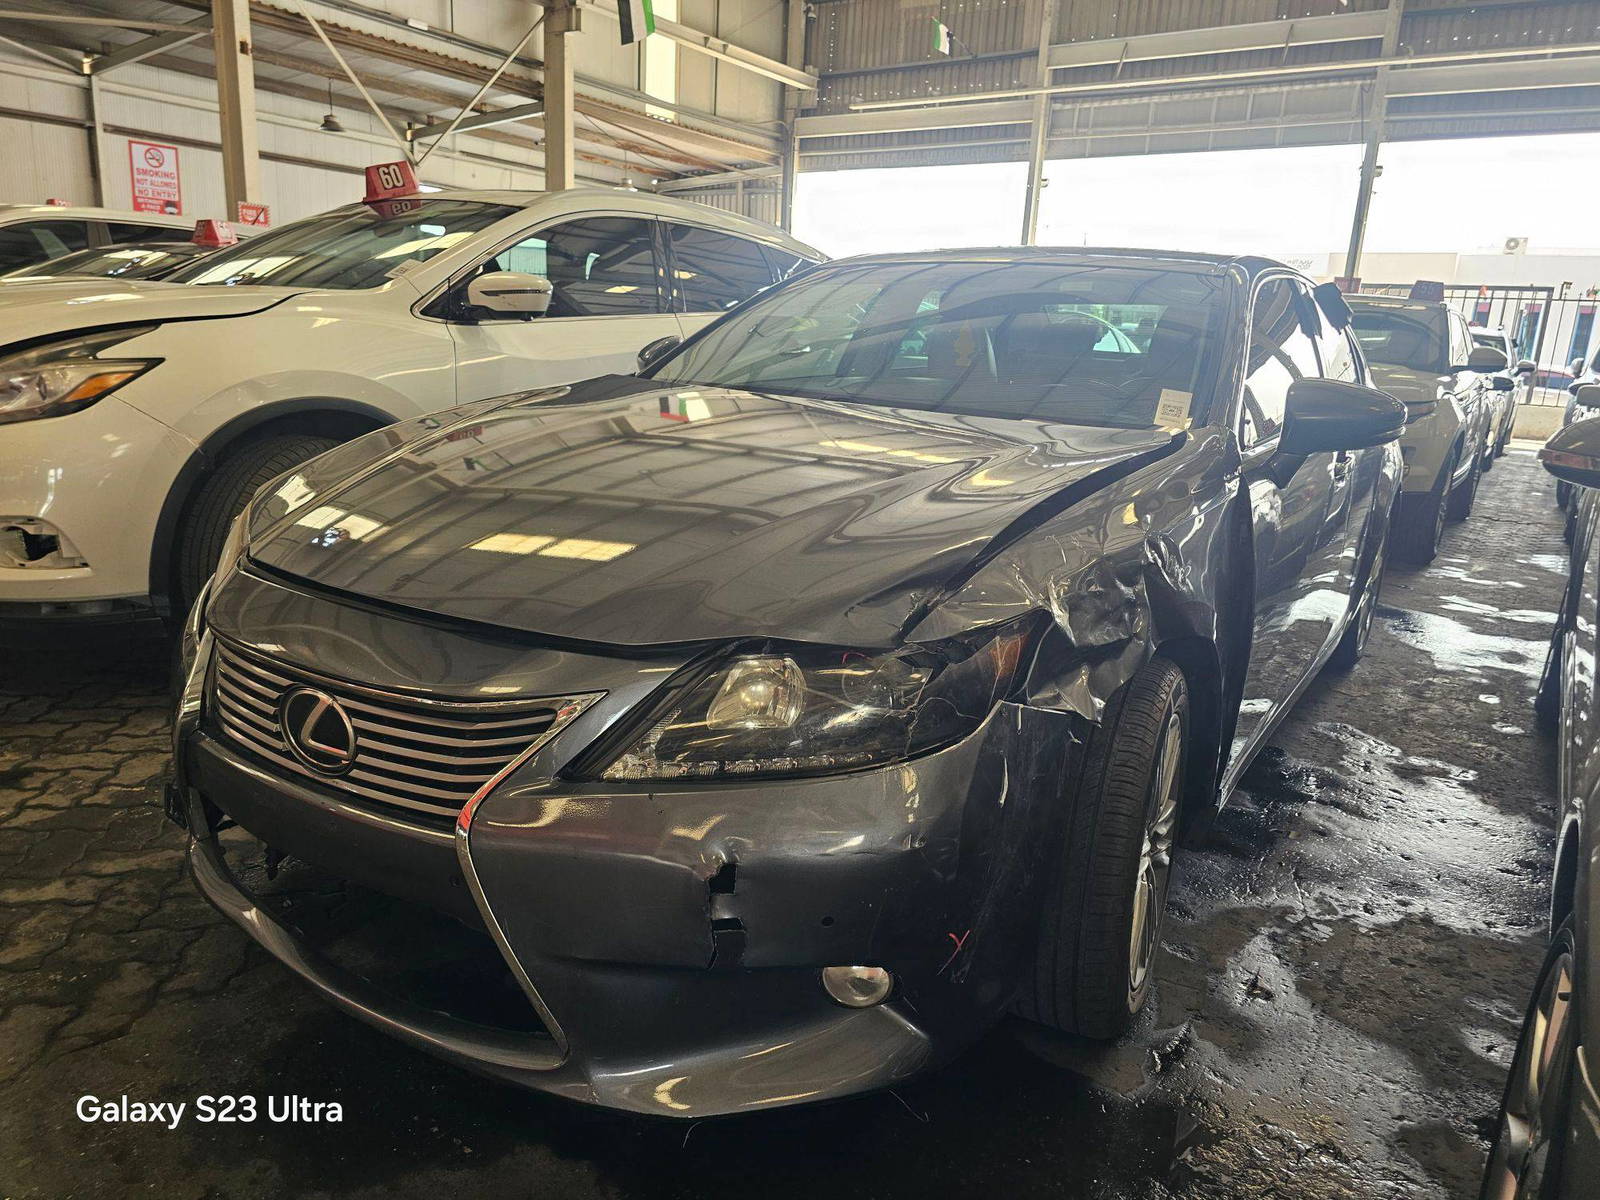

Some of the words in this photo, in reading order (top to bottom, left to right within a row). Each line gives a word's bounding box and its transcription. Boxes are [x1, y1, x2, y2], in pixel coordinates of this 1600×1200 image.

[136, 168, 175, 179] SMOKING
[377, 163, 405, 190] 60
[136, 178, 149, 187] NOT
[137, 189, 149, 197] NO
[151, 190, 177, 199] ENTRY
